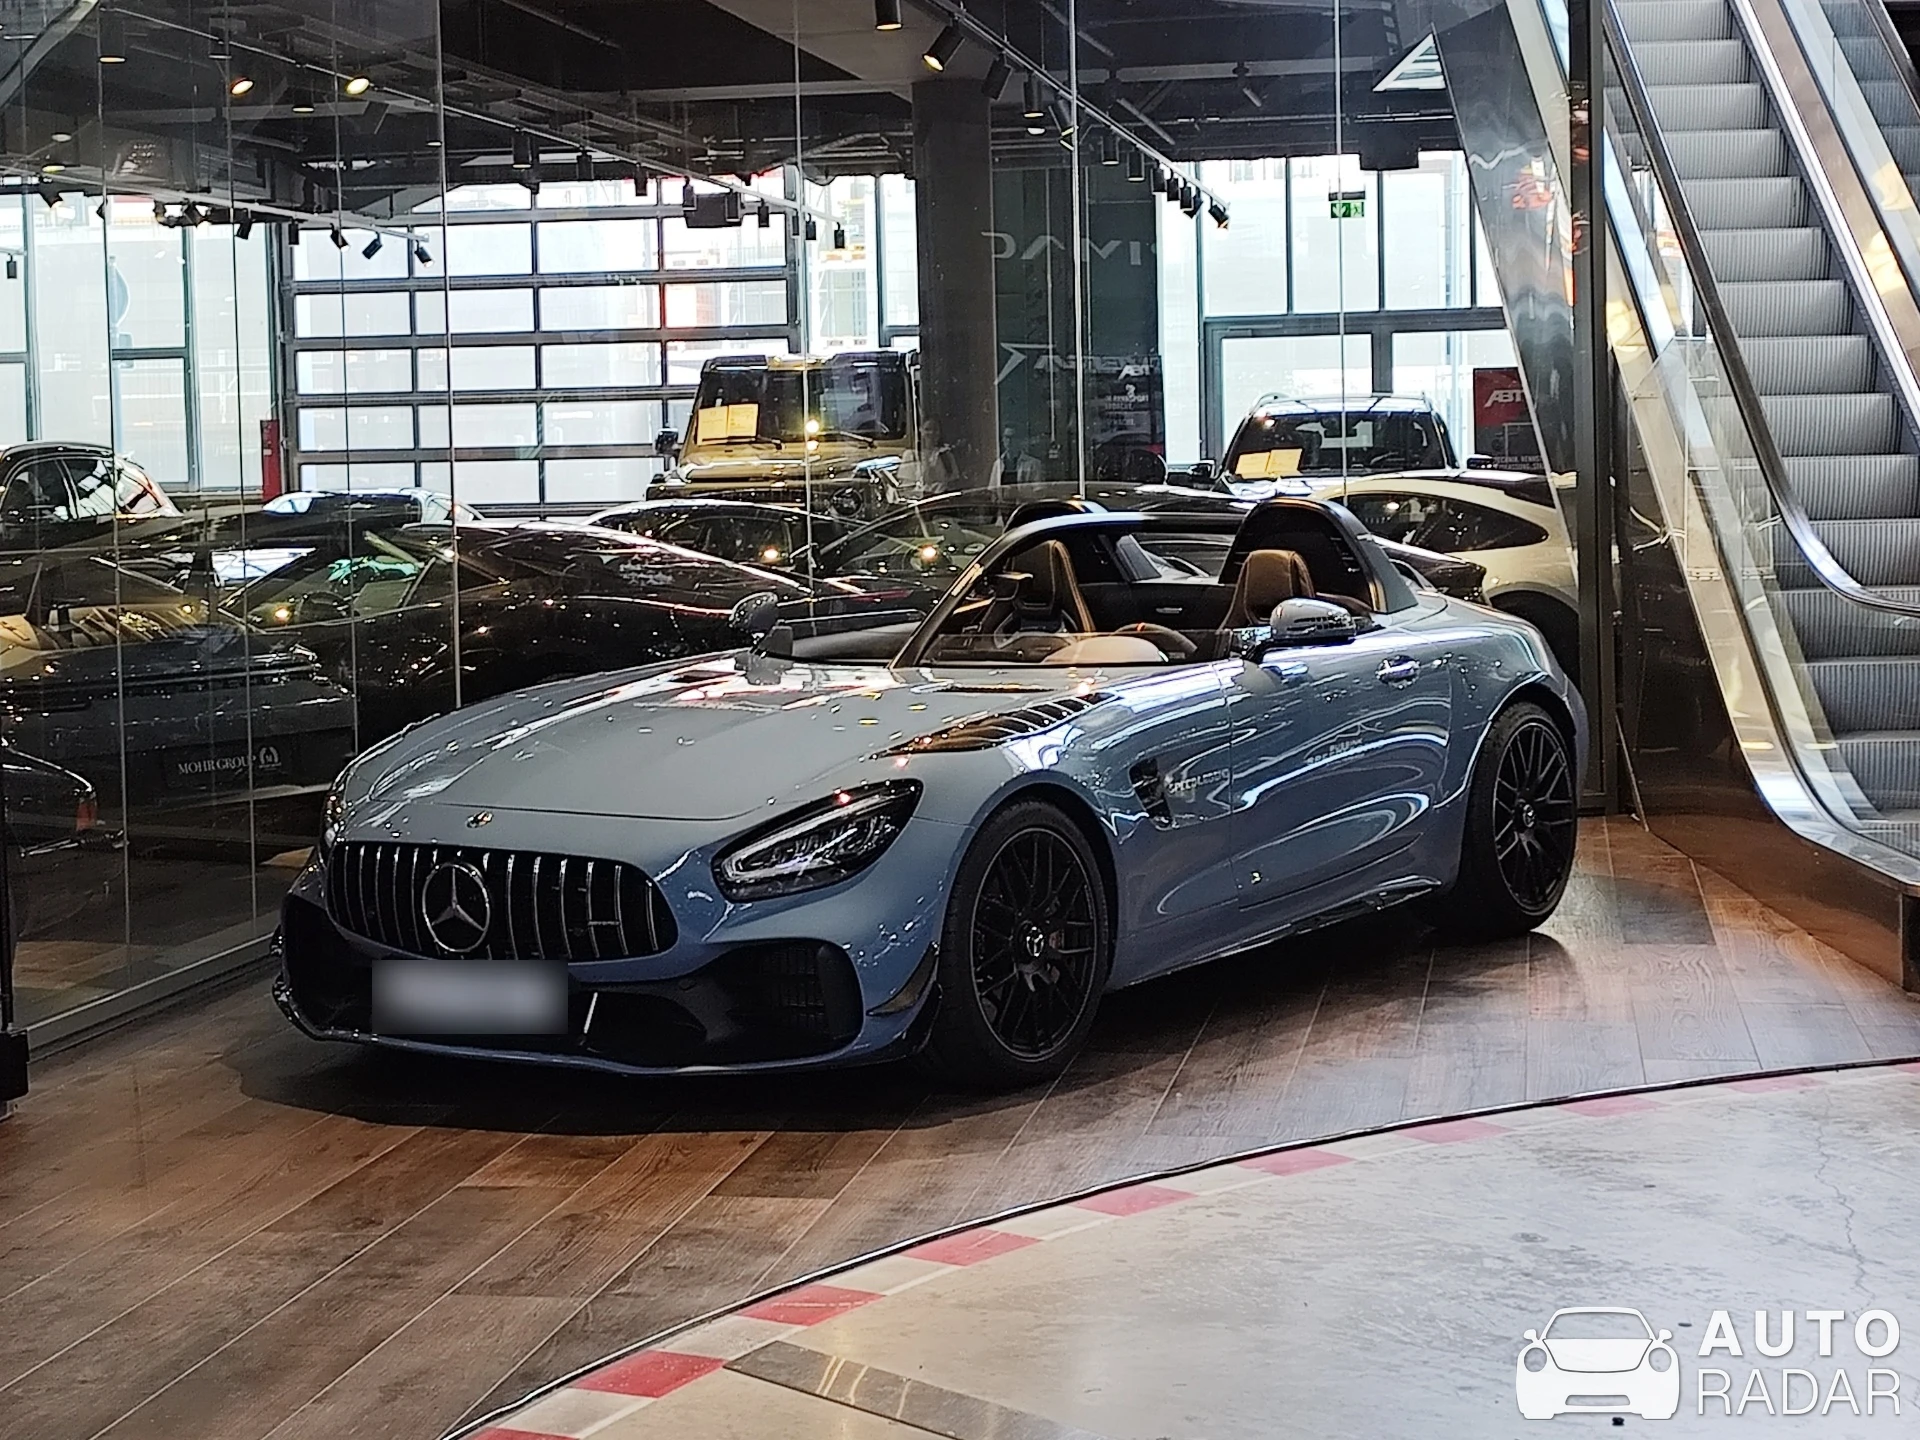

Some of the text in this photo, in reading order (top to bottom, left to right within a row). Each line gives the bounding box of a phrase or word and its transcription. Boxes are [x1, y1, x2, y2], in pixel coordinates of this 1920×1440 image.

[1483, 389, 1525, 408] ABT
[178, 759, 215, 775] MOHR
[216, 755, 257, 770] GROUP
